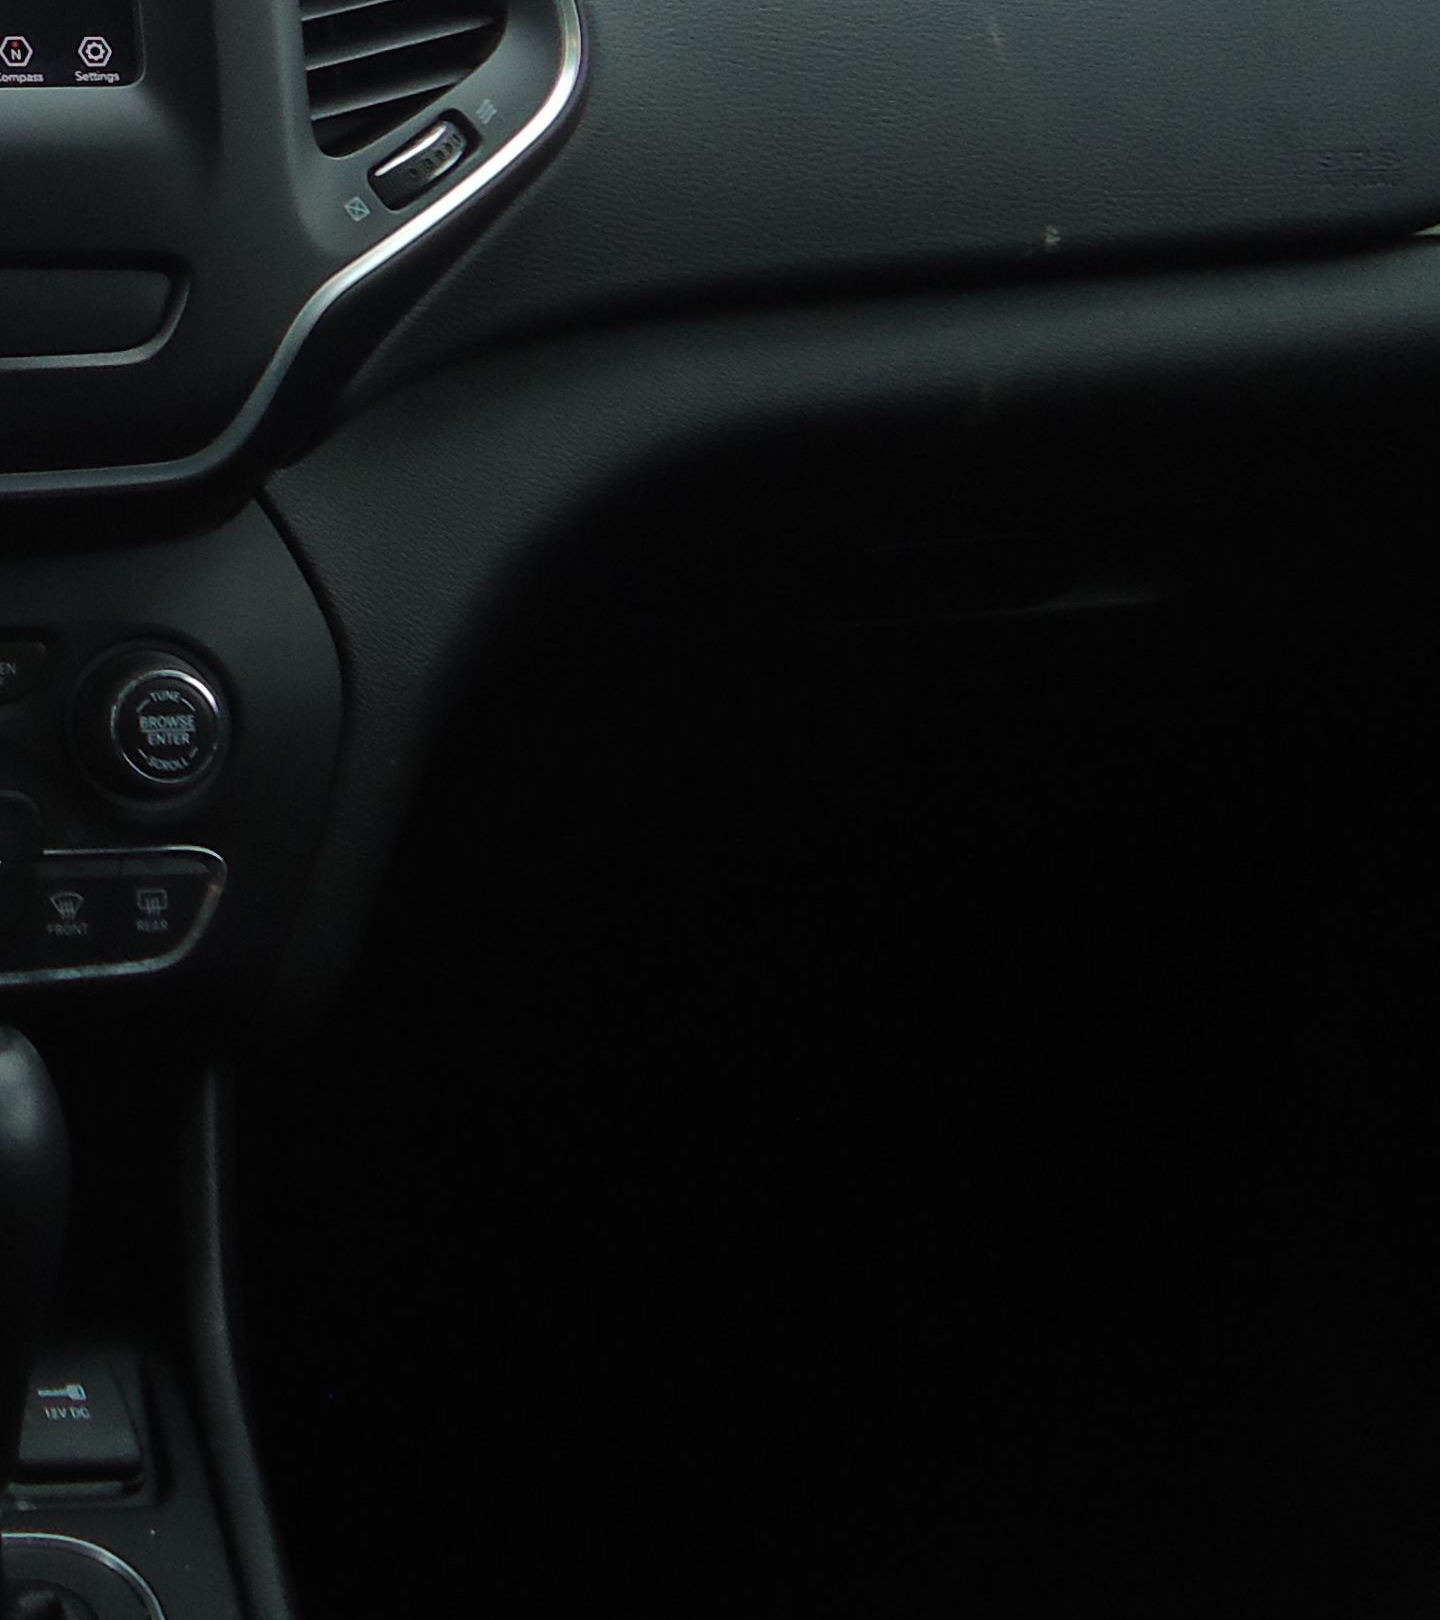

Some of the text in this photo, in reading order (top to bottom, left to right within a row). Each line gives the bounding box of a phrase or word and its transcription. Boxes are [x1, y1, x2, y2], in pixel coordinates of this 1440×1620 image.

[74, 70, 120, 83] Settings
[149, 689, 181, 703] TUNE
[140, 714, 197, 730] BROWSE
[147, 732, 191, 747] ENTER
[147, 755, 190, 773] SCROLL
[47, 922, 89, 937] FRONT
[136, 919, 169, 933] REAR
